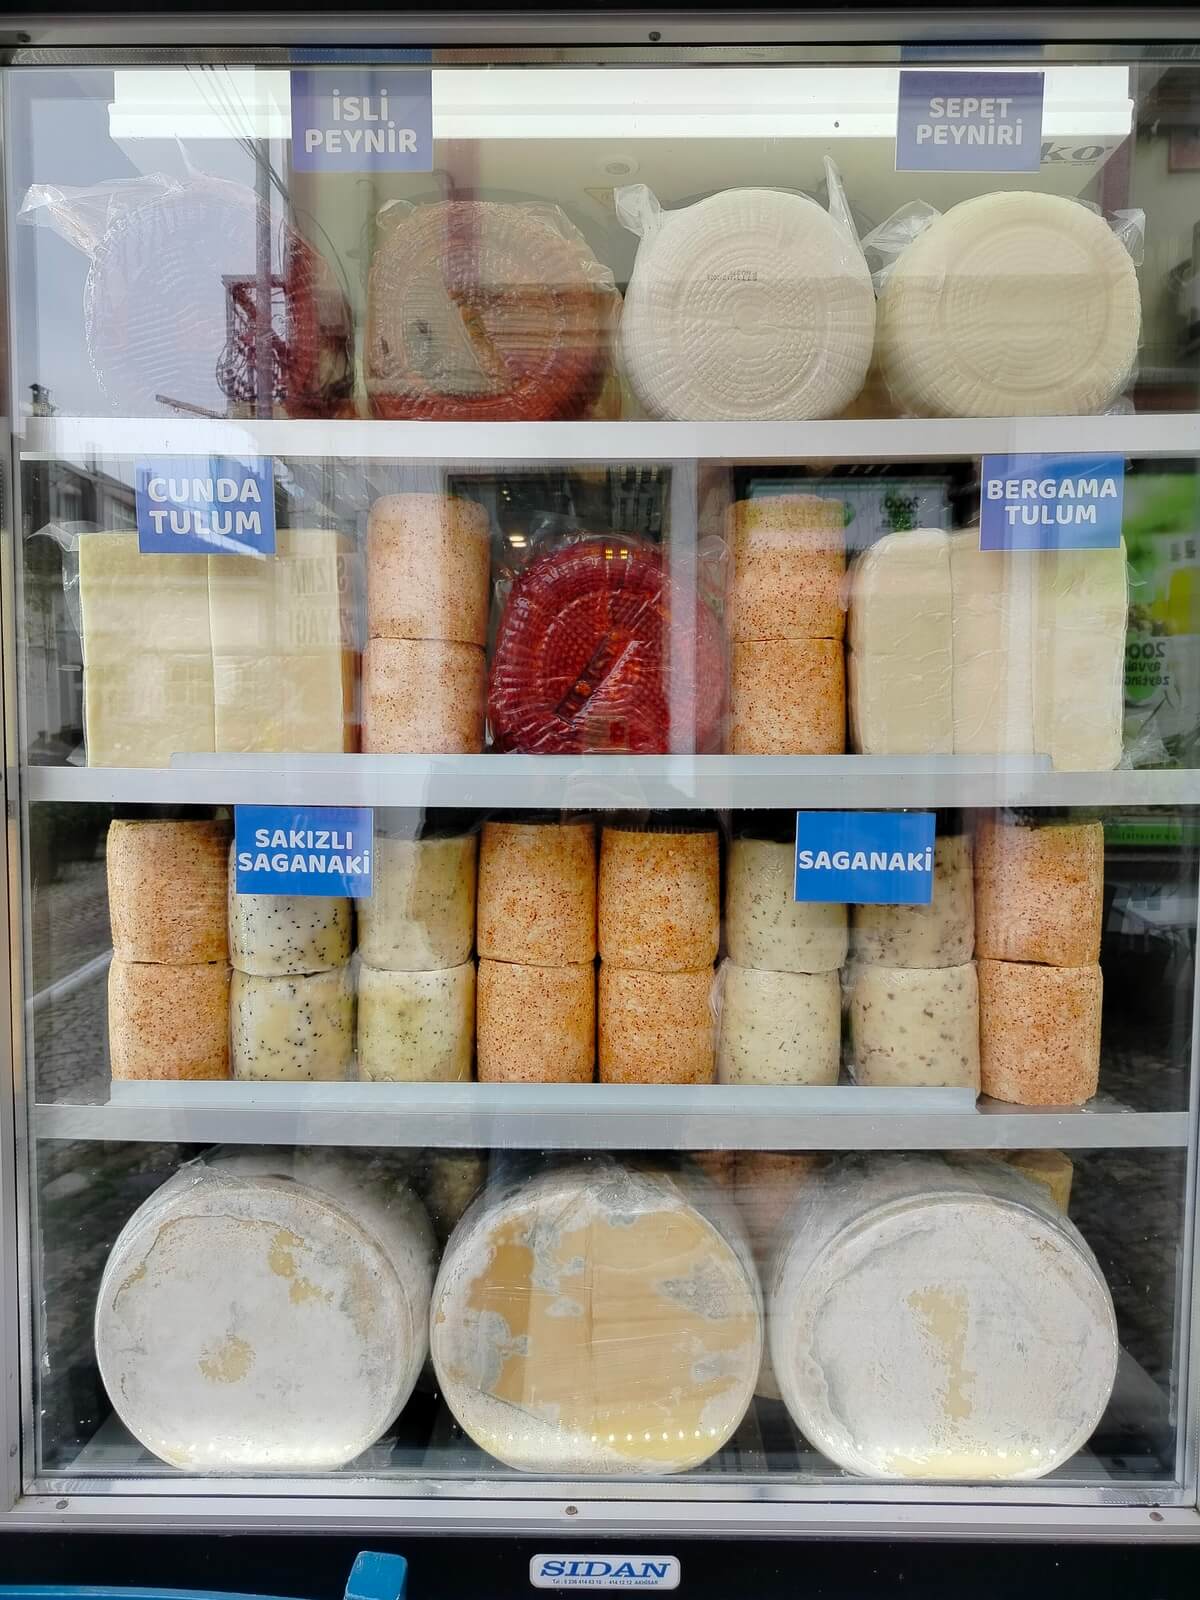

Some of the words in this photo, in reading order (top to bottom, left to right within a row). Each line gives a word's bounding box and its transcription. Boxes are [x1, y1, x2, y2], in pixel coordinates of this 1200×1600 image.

[332, 89, 388, 121] İSLİ
[929, 97, 1013, 118] SEPET
[305, 121, 418, 153] PEYNİR
[916, 118, 1022, 145] PEYNİRİ
[148, 478, 262, 503] CUNDA
[987, 479, 1118, 499] BERGAMA
[149, 510, 262, 535] TULUM
[1004, 504, 1097, 525] TULUM
[255, 829, 353, 850] SAKIZLI
[238, 850, 371, 874] SAGANAKİ
[799, 847, 932, 871] SAGANAKİ
[540, 1560, 671, 1577] SIDAN
